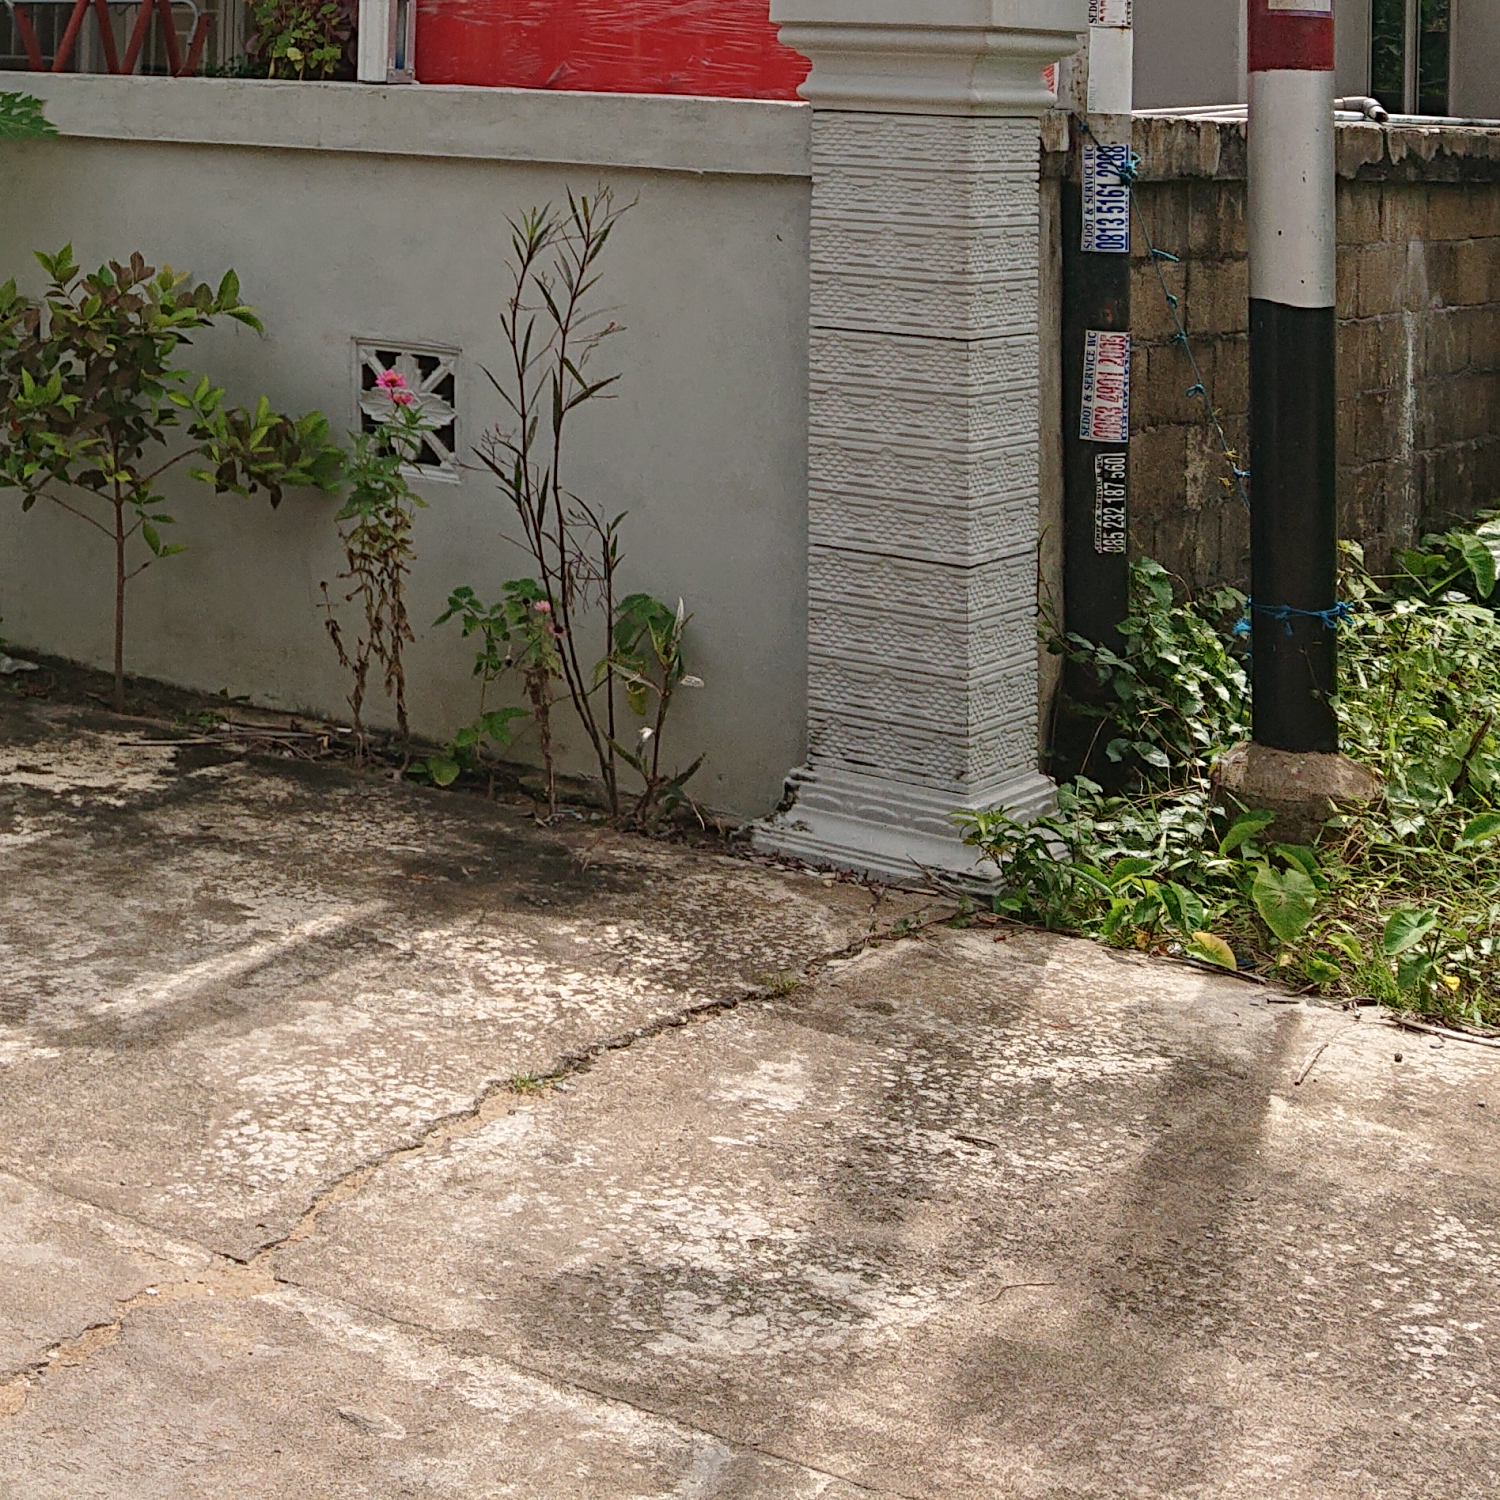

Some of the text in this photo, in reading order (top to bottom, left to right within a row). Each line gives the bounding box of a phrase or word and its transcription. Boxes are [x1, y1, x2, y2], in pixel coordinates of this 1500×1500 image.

[1084, 146, 1094, 249] SEDOT & SERVICE WC
[1095, 146, 1126, 250] 0813 5161 2288
[1098, 334, 1126, 367] 2005
[1081, 331, 1097, 437] SEDOT & SERVICE WC
[1103, 482, 1125, 503] 187
[1102, 507, 1124, 528] 232
[1102, 531, 1124, 553] 085
